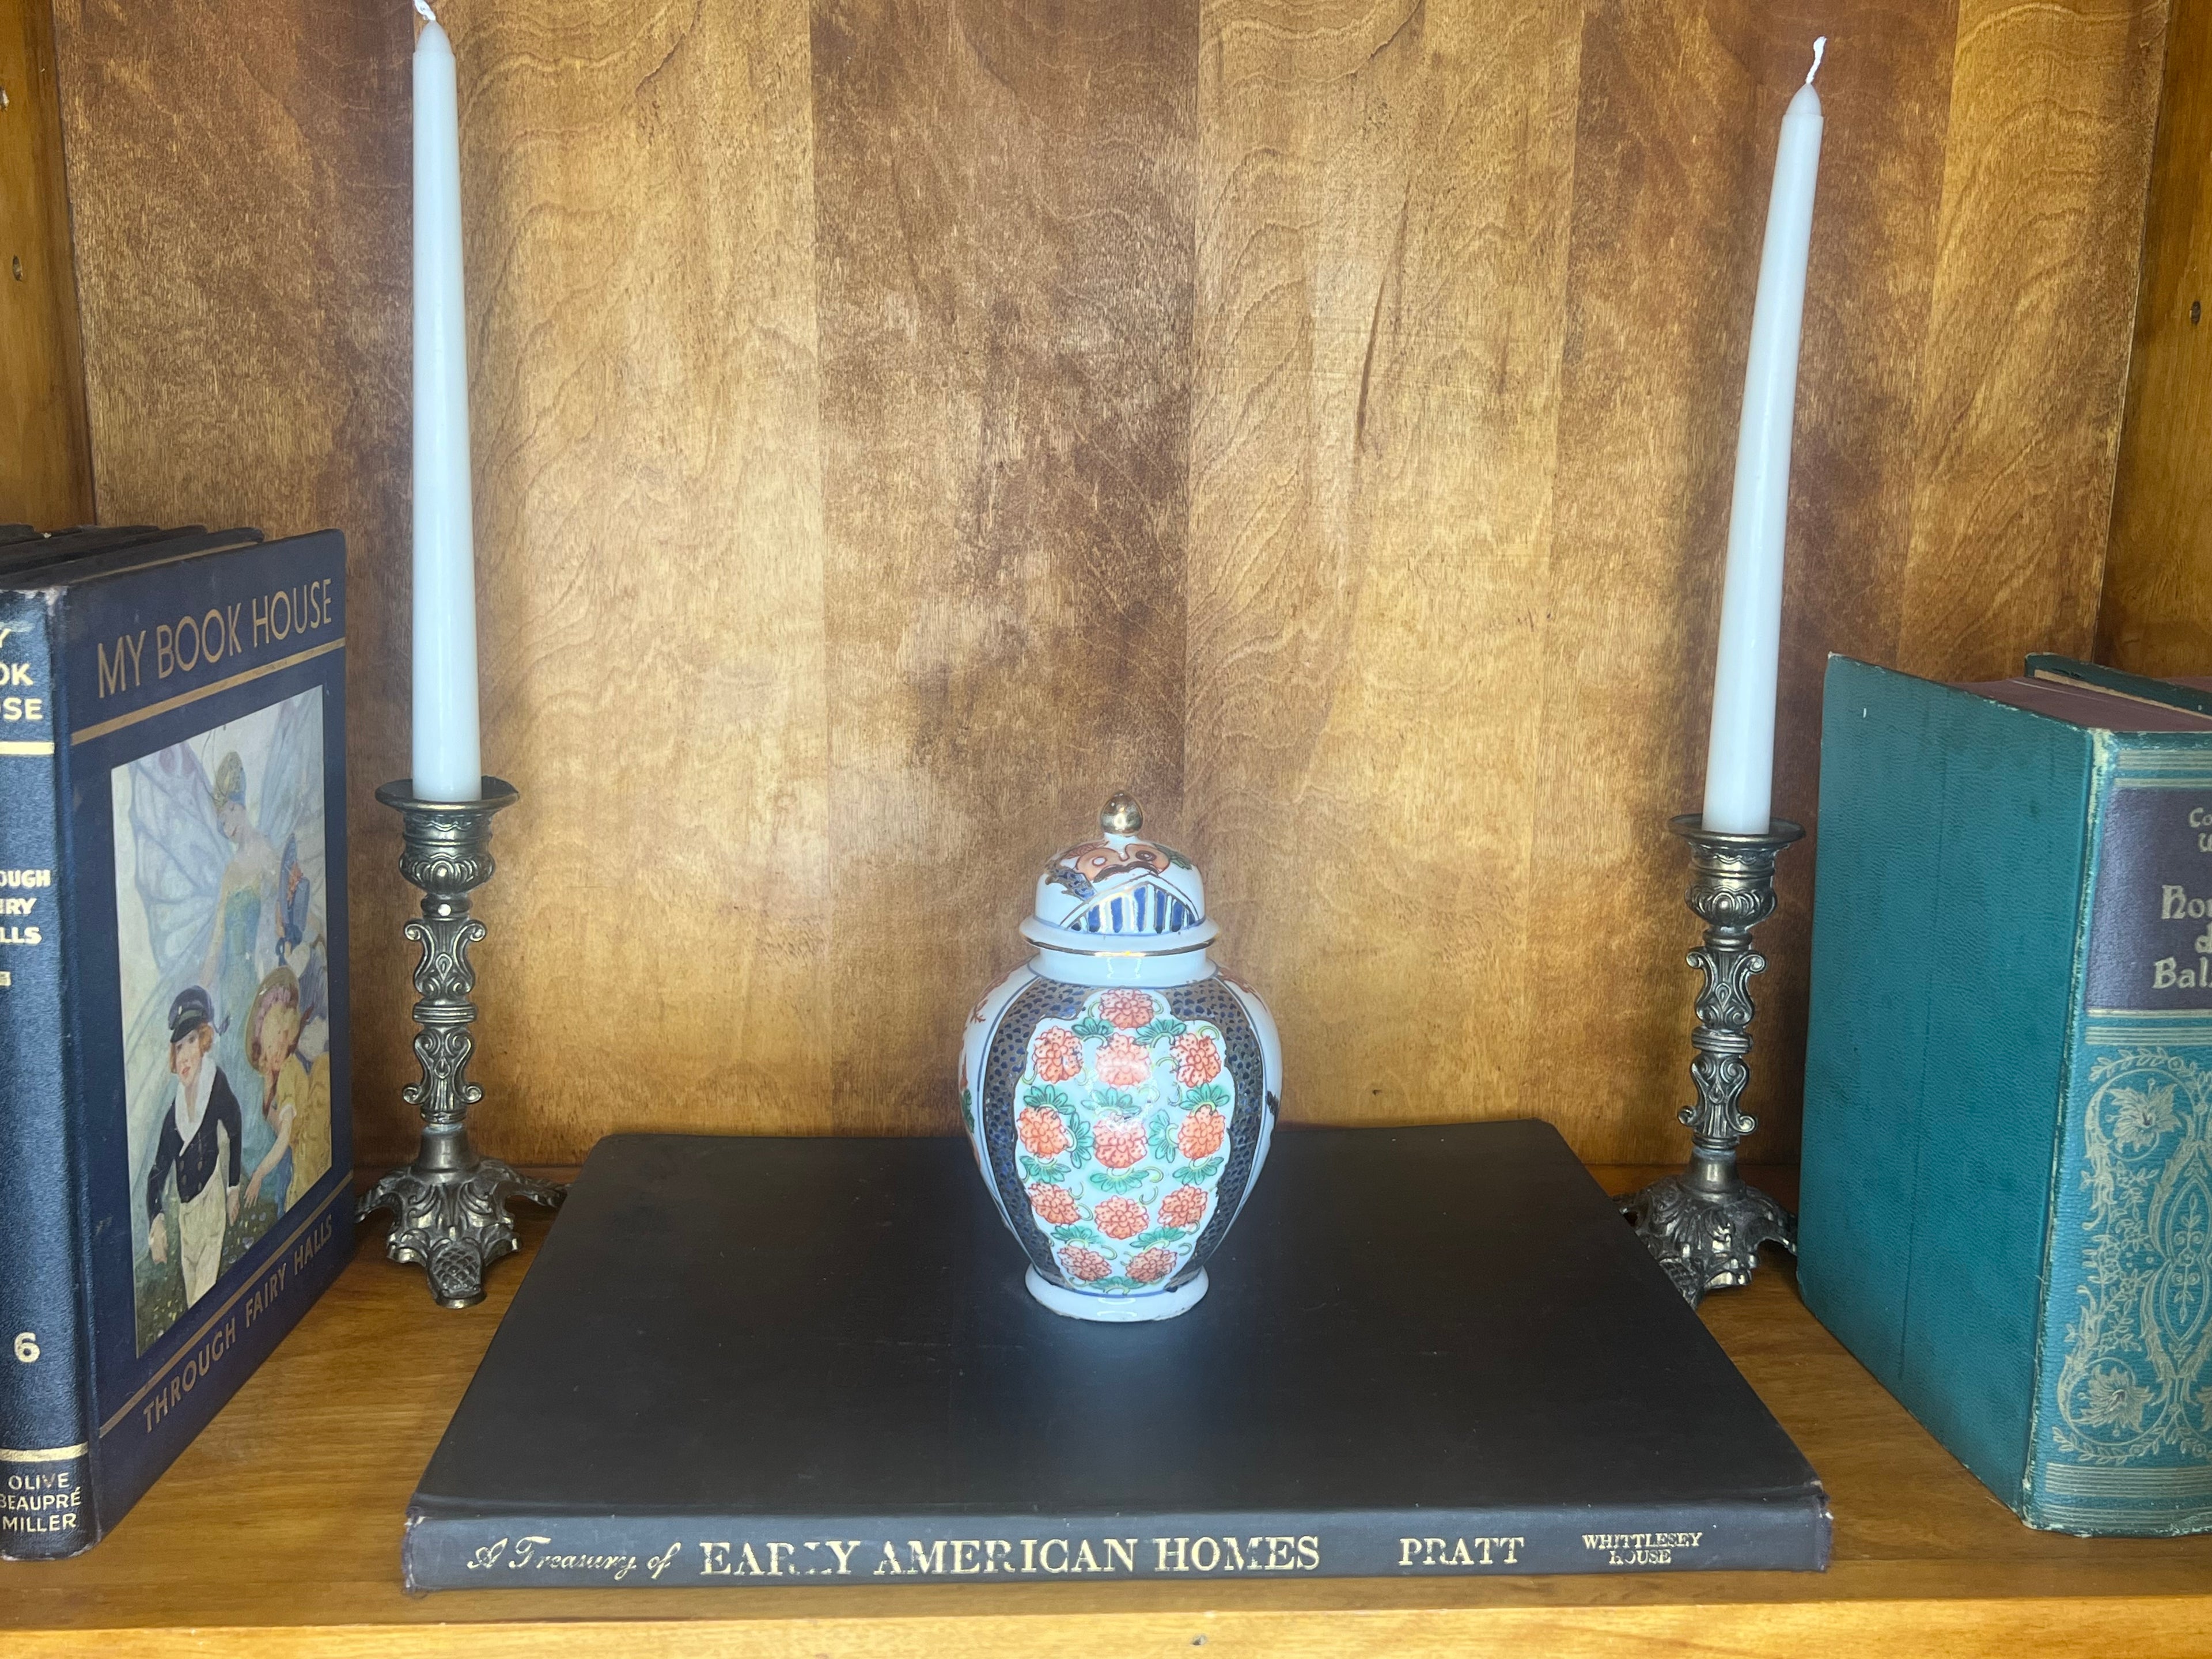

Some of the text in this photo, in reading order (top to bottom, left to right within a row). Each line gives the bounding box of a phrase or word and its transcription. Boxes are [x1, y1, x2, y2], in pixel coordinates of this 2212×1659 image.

[98, 578, 332, 698] MY BOOK HOUSE
[2152, 956, 2212, 989] Bal
[143, 1214, 332, 1434] THROUGH FAIRY HALLS
[14, 1332, 40, 1363] 6
[8, 1472, 70, 1490] OLIVE
[2, 1513, 77, 1533] MILLER
[1582, 1532, 1703, 1550] WHITTLESEY
[508, 1536, 637, 1581] Treasury
[646, 1541, 682, 1580] of
[873, 1537, 1139, 1575] AMERICAN
[1154, 1535, 1321, 1573] HOMES
[1398, 1536, 1525, 1566] PRATT
